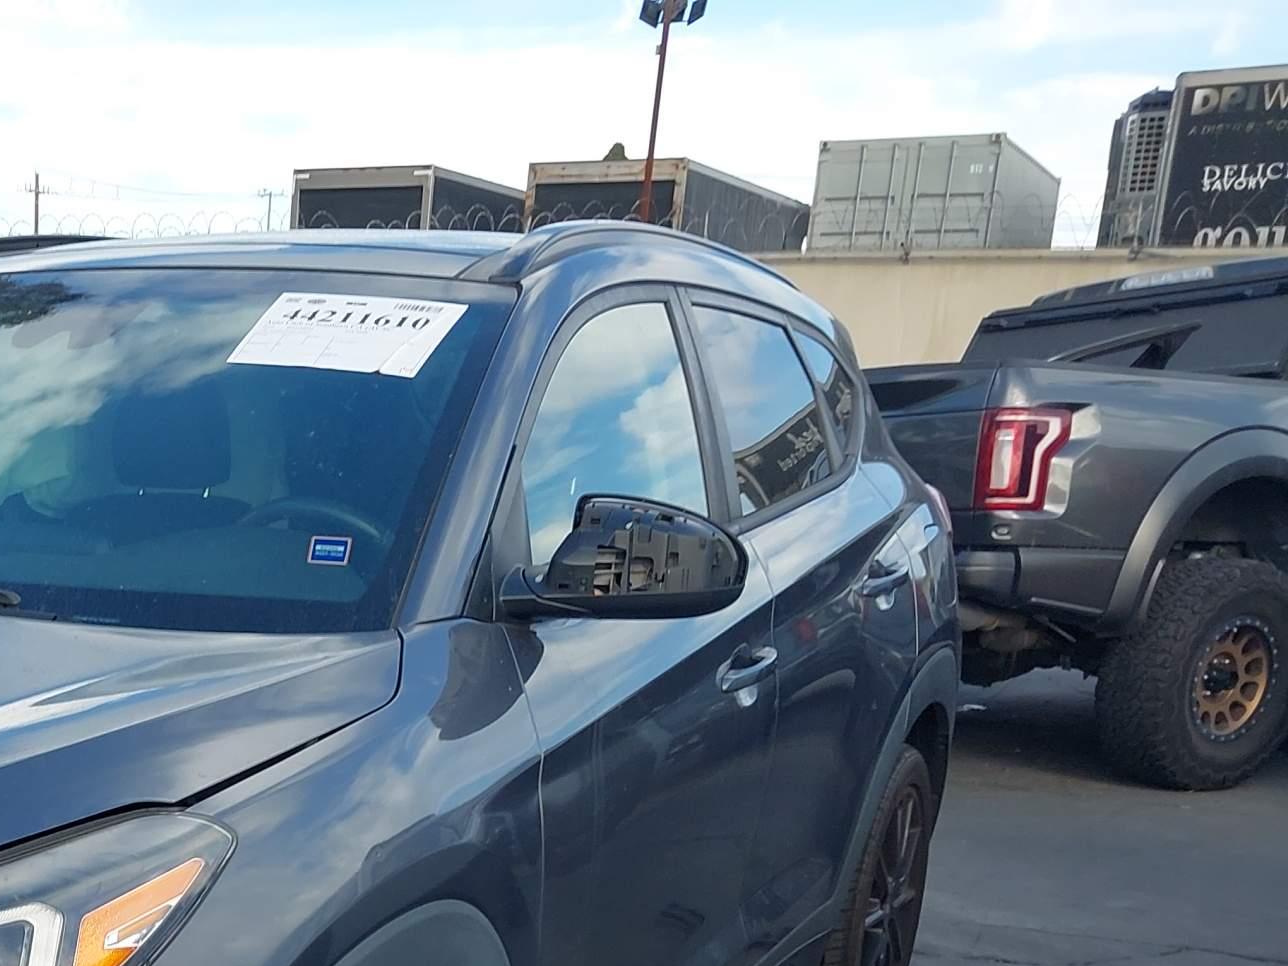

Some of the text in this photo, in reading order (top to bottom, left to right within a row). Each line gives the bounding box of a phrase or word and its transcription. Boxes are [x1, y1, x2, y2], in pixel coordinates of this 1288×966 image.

[1201, 175, 1268, 192] SAVORY
[1202, 162, 1288, 188] DELIC
[283, 308, 431, 331] 44211610
